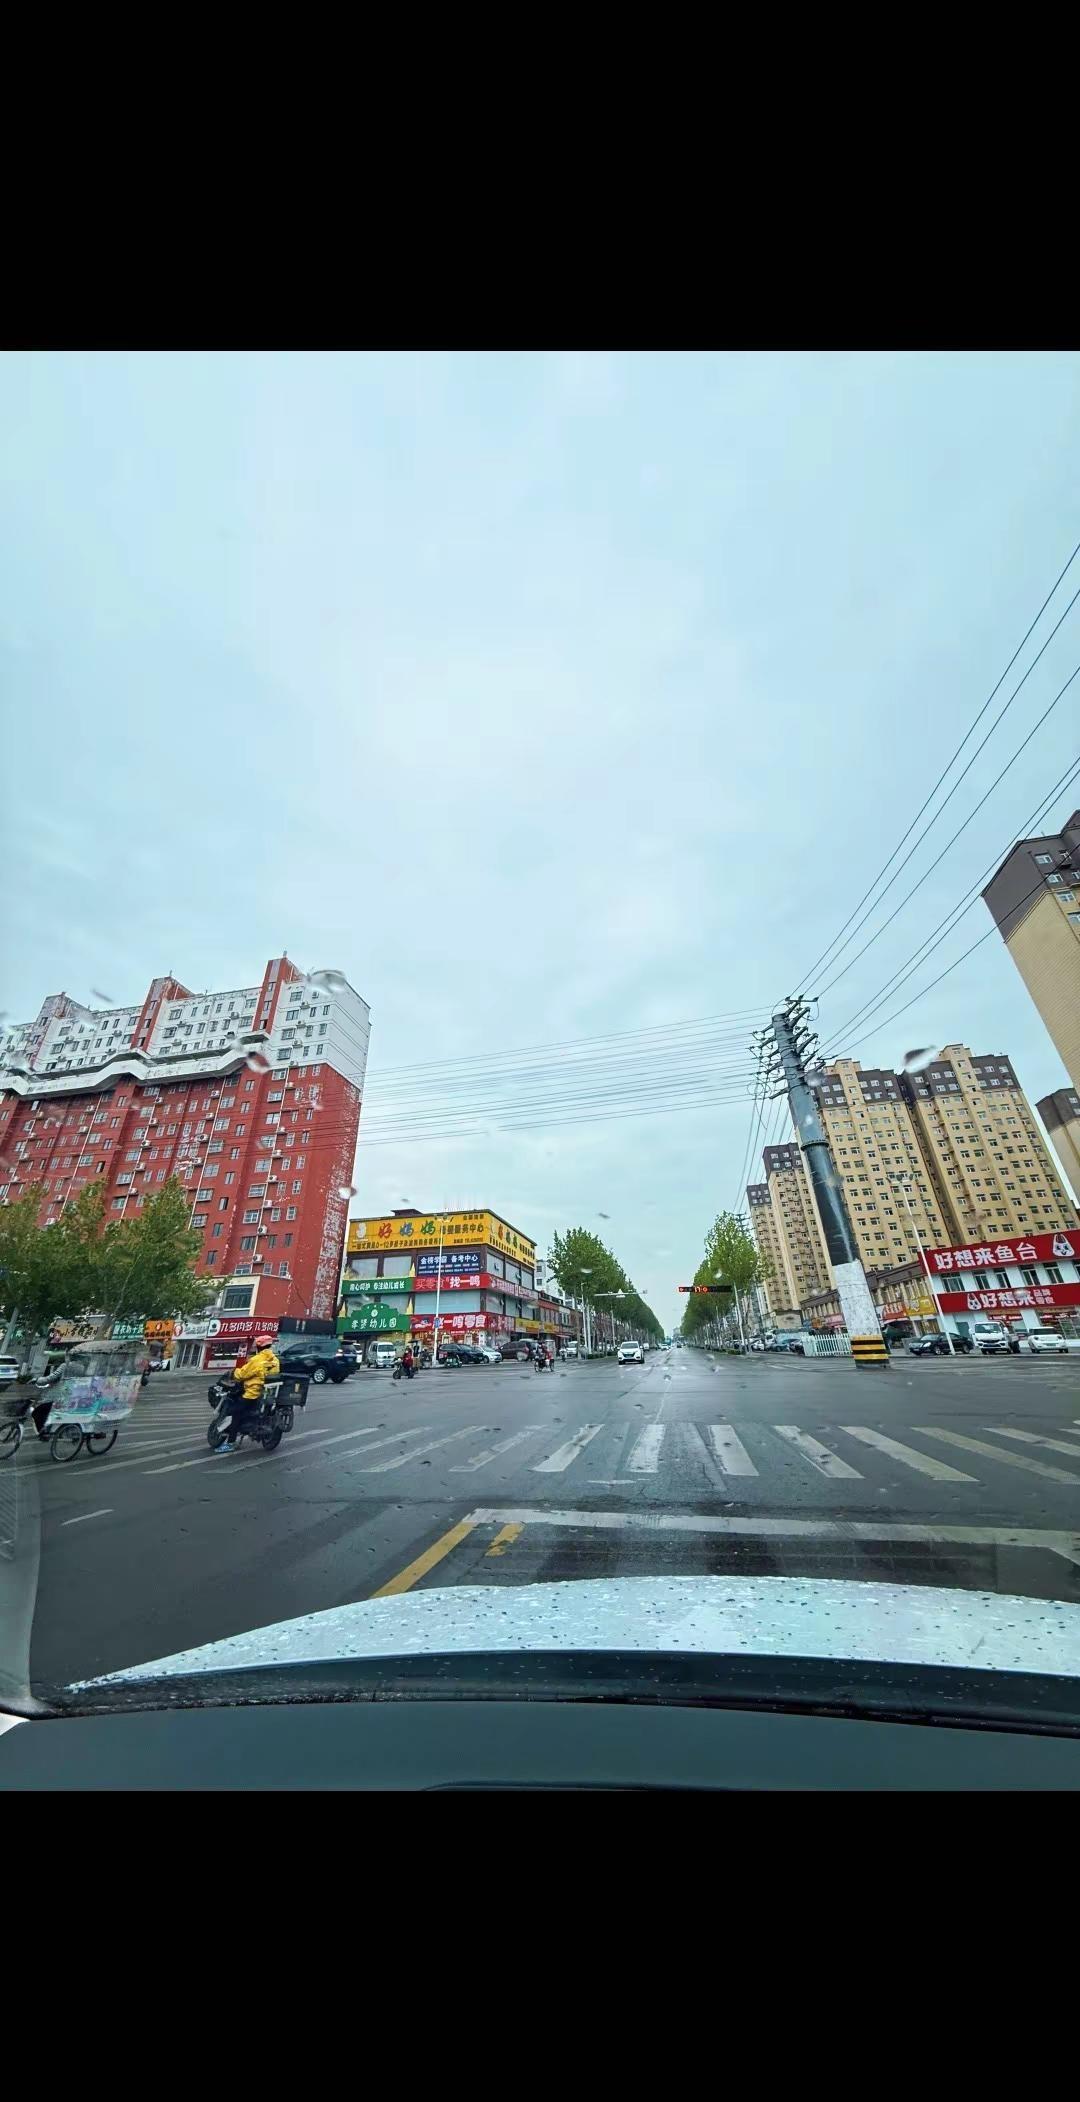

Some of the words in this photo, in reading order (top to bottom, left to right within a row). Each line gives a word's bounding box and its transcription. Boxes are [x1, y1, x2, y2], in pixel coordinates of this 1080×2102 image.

[934, 1242, 1038, 1270] 好想来鱼台
[980, 1289, 1036, 1308] 好想来
